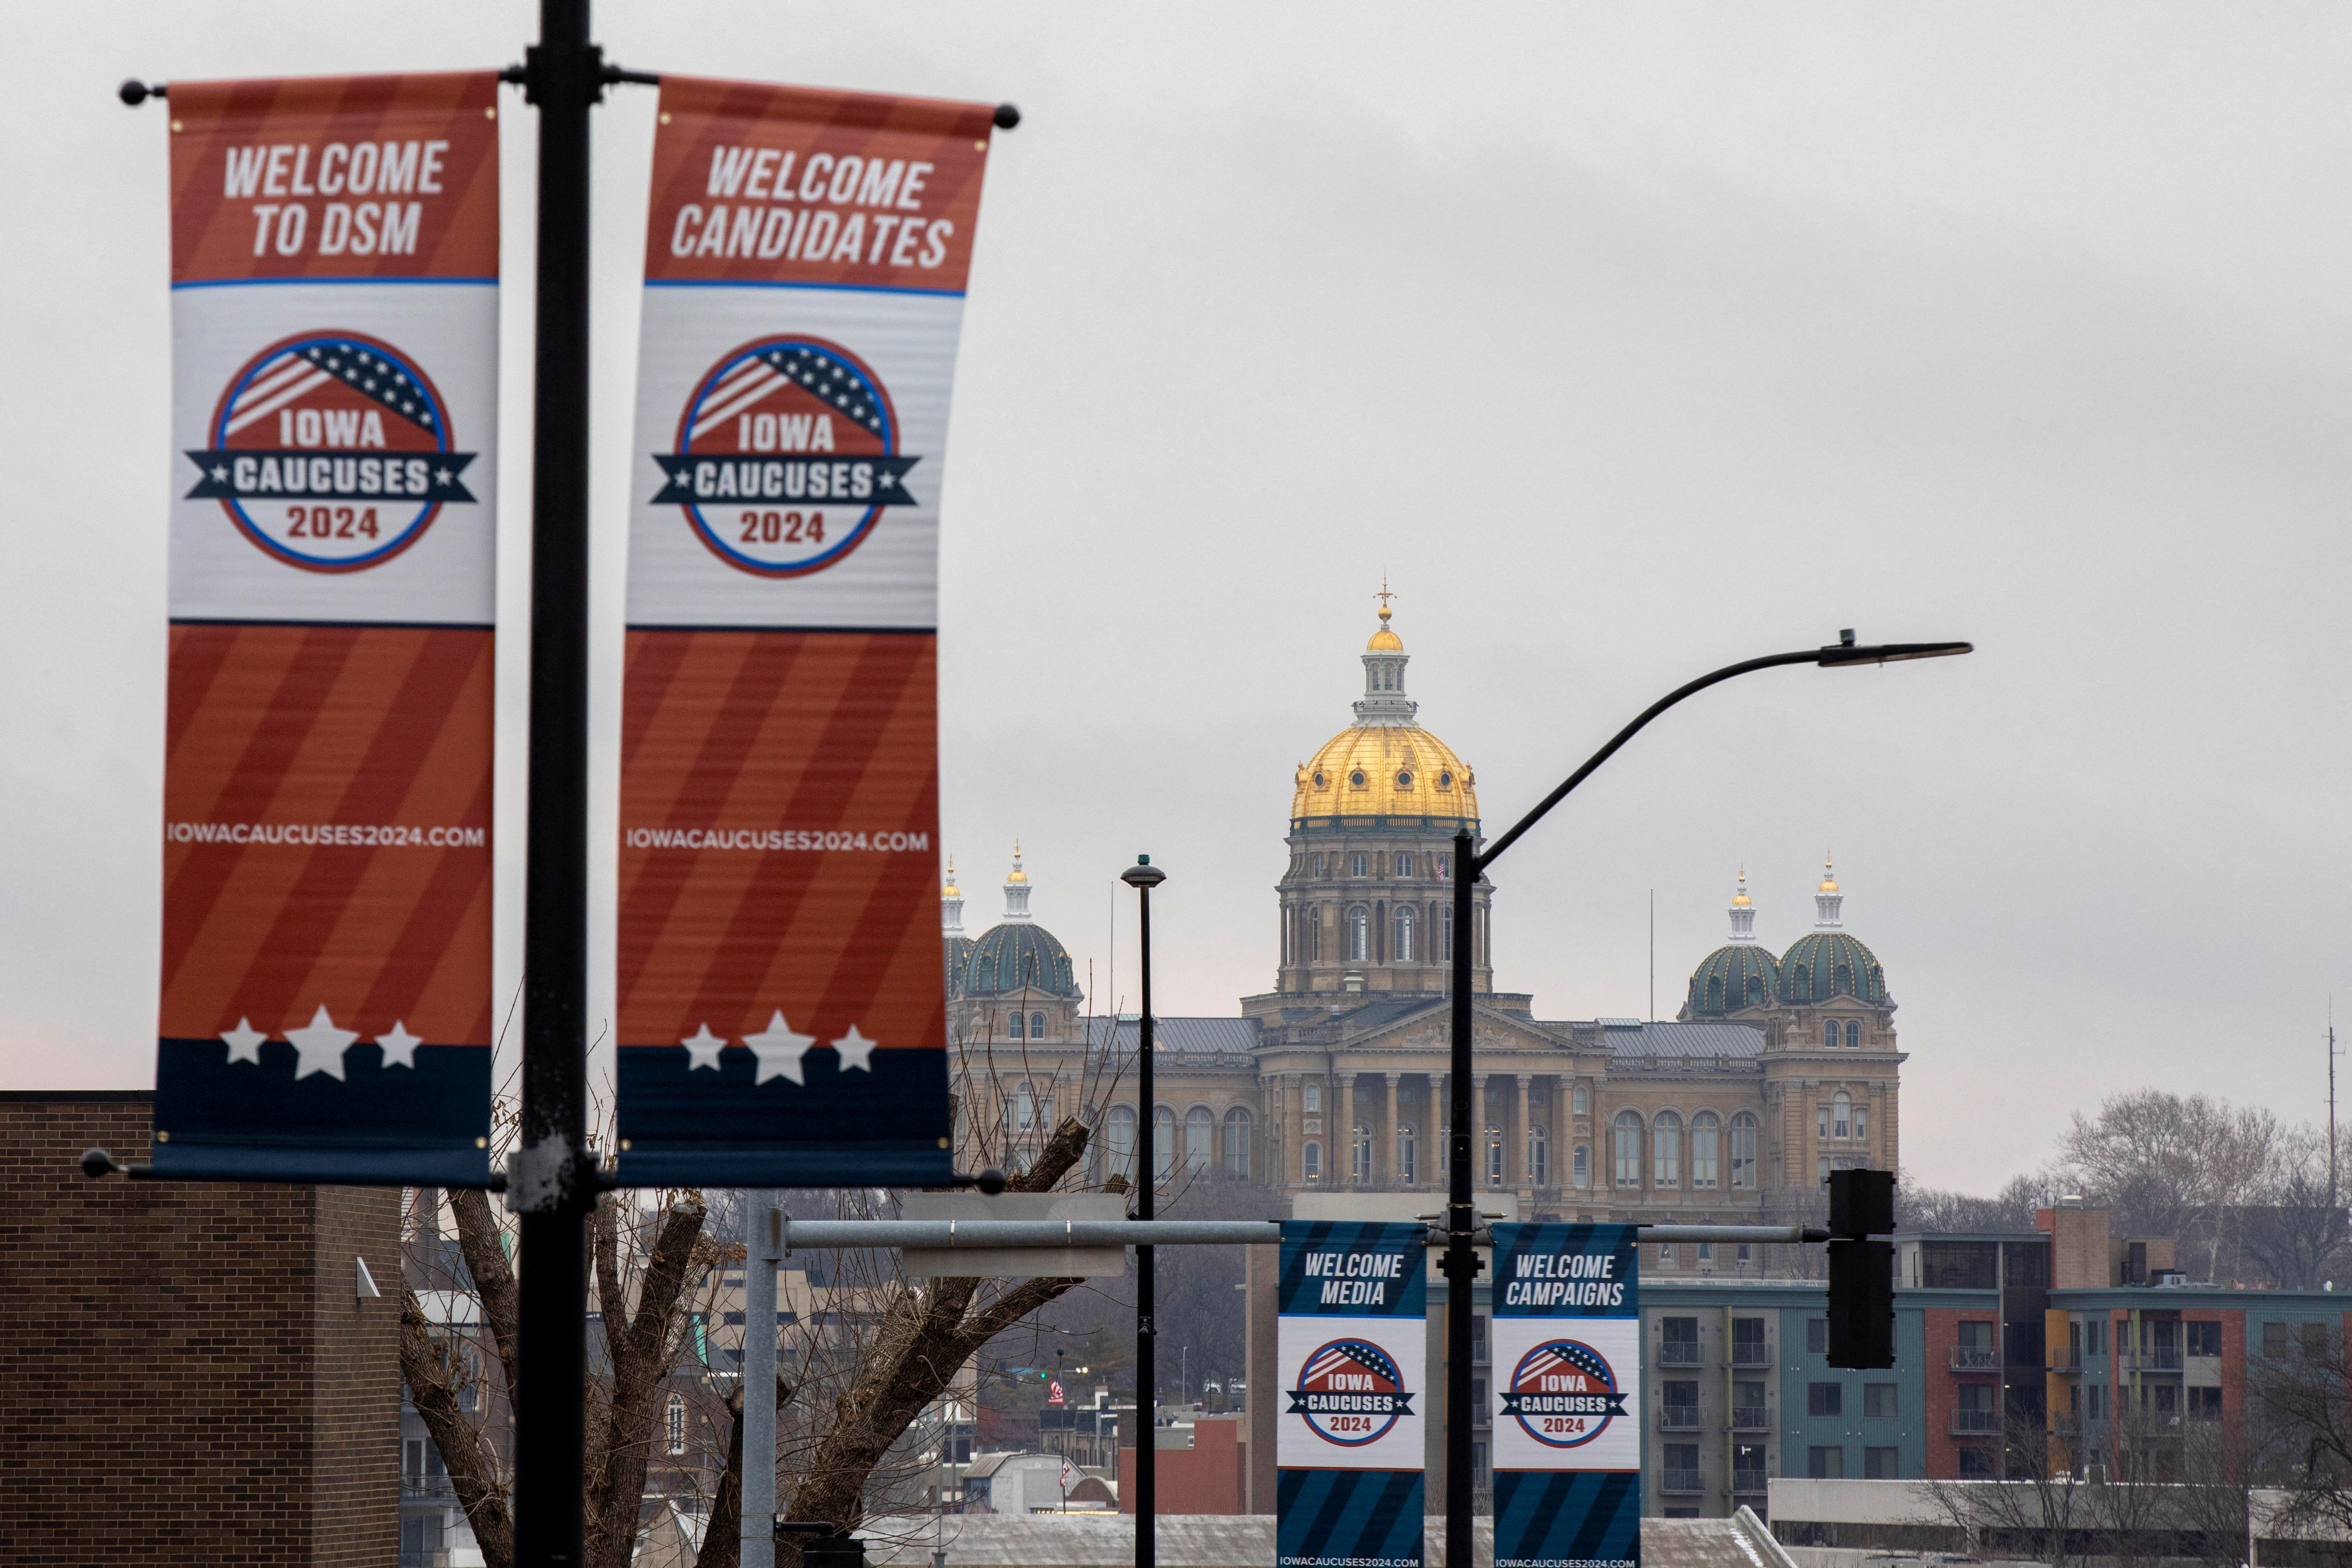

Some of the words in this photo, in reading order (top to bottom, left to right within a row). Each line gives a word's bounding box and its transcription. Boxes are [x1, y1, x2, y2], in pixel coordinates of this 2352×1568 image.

[224, 140, 449, 198] WELCOME
[706, 145, 934, 210] WELCOME
[253, 203, 307, 256] TO
[318, 202, 422, 255] DSM
[671, 204, 954, 268] CANDIDATES
[280, 409, 386, 449] IOWA
[738, 413, 835, 453] IOWA
[233, 456, 429, 495] CAUCUSES
[695, 462, 873, 498] CAUCUSES
[287, 506, 379, 539] 2024
[740, 511, 824, 543] 2024
[167, 822, 484, 847] IOWACAUCUSES2024.COM
[627, 828, 928, 851] IOWACAUCUSES2024.COM
[1305, 1253, 1404, 1278] WELCOME
[1516, 1254, 1615, 1278] WELCOME
[1320, 1281, 1384, 1305] MEDIA
[1506, 1282, 1624, 1306] CAMPAIGNS
[1328, 1373, 1374, 1391] IOWA
[1541, 1375, 1587, 1392] IOWA
[1308, 1394, 1393, 1411] CAUCUSES
[1521, 1396, 1606, 1412] CAUCUSES
[1330, 1417, 1371, 1432] 2024
[1544, 1418, 1585, 1433] 2024
[1280, 1557, 1418, 1567] IOWACAUCUSES2024.COM
[1496, 1559, 1635, 1568] IOWACAUCUSES2024.COM
